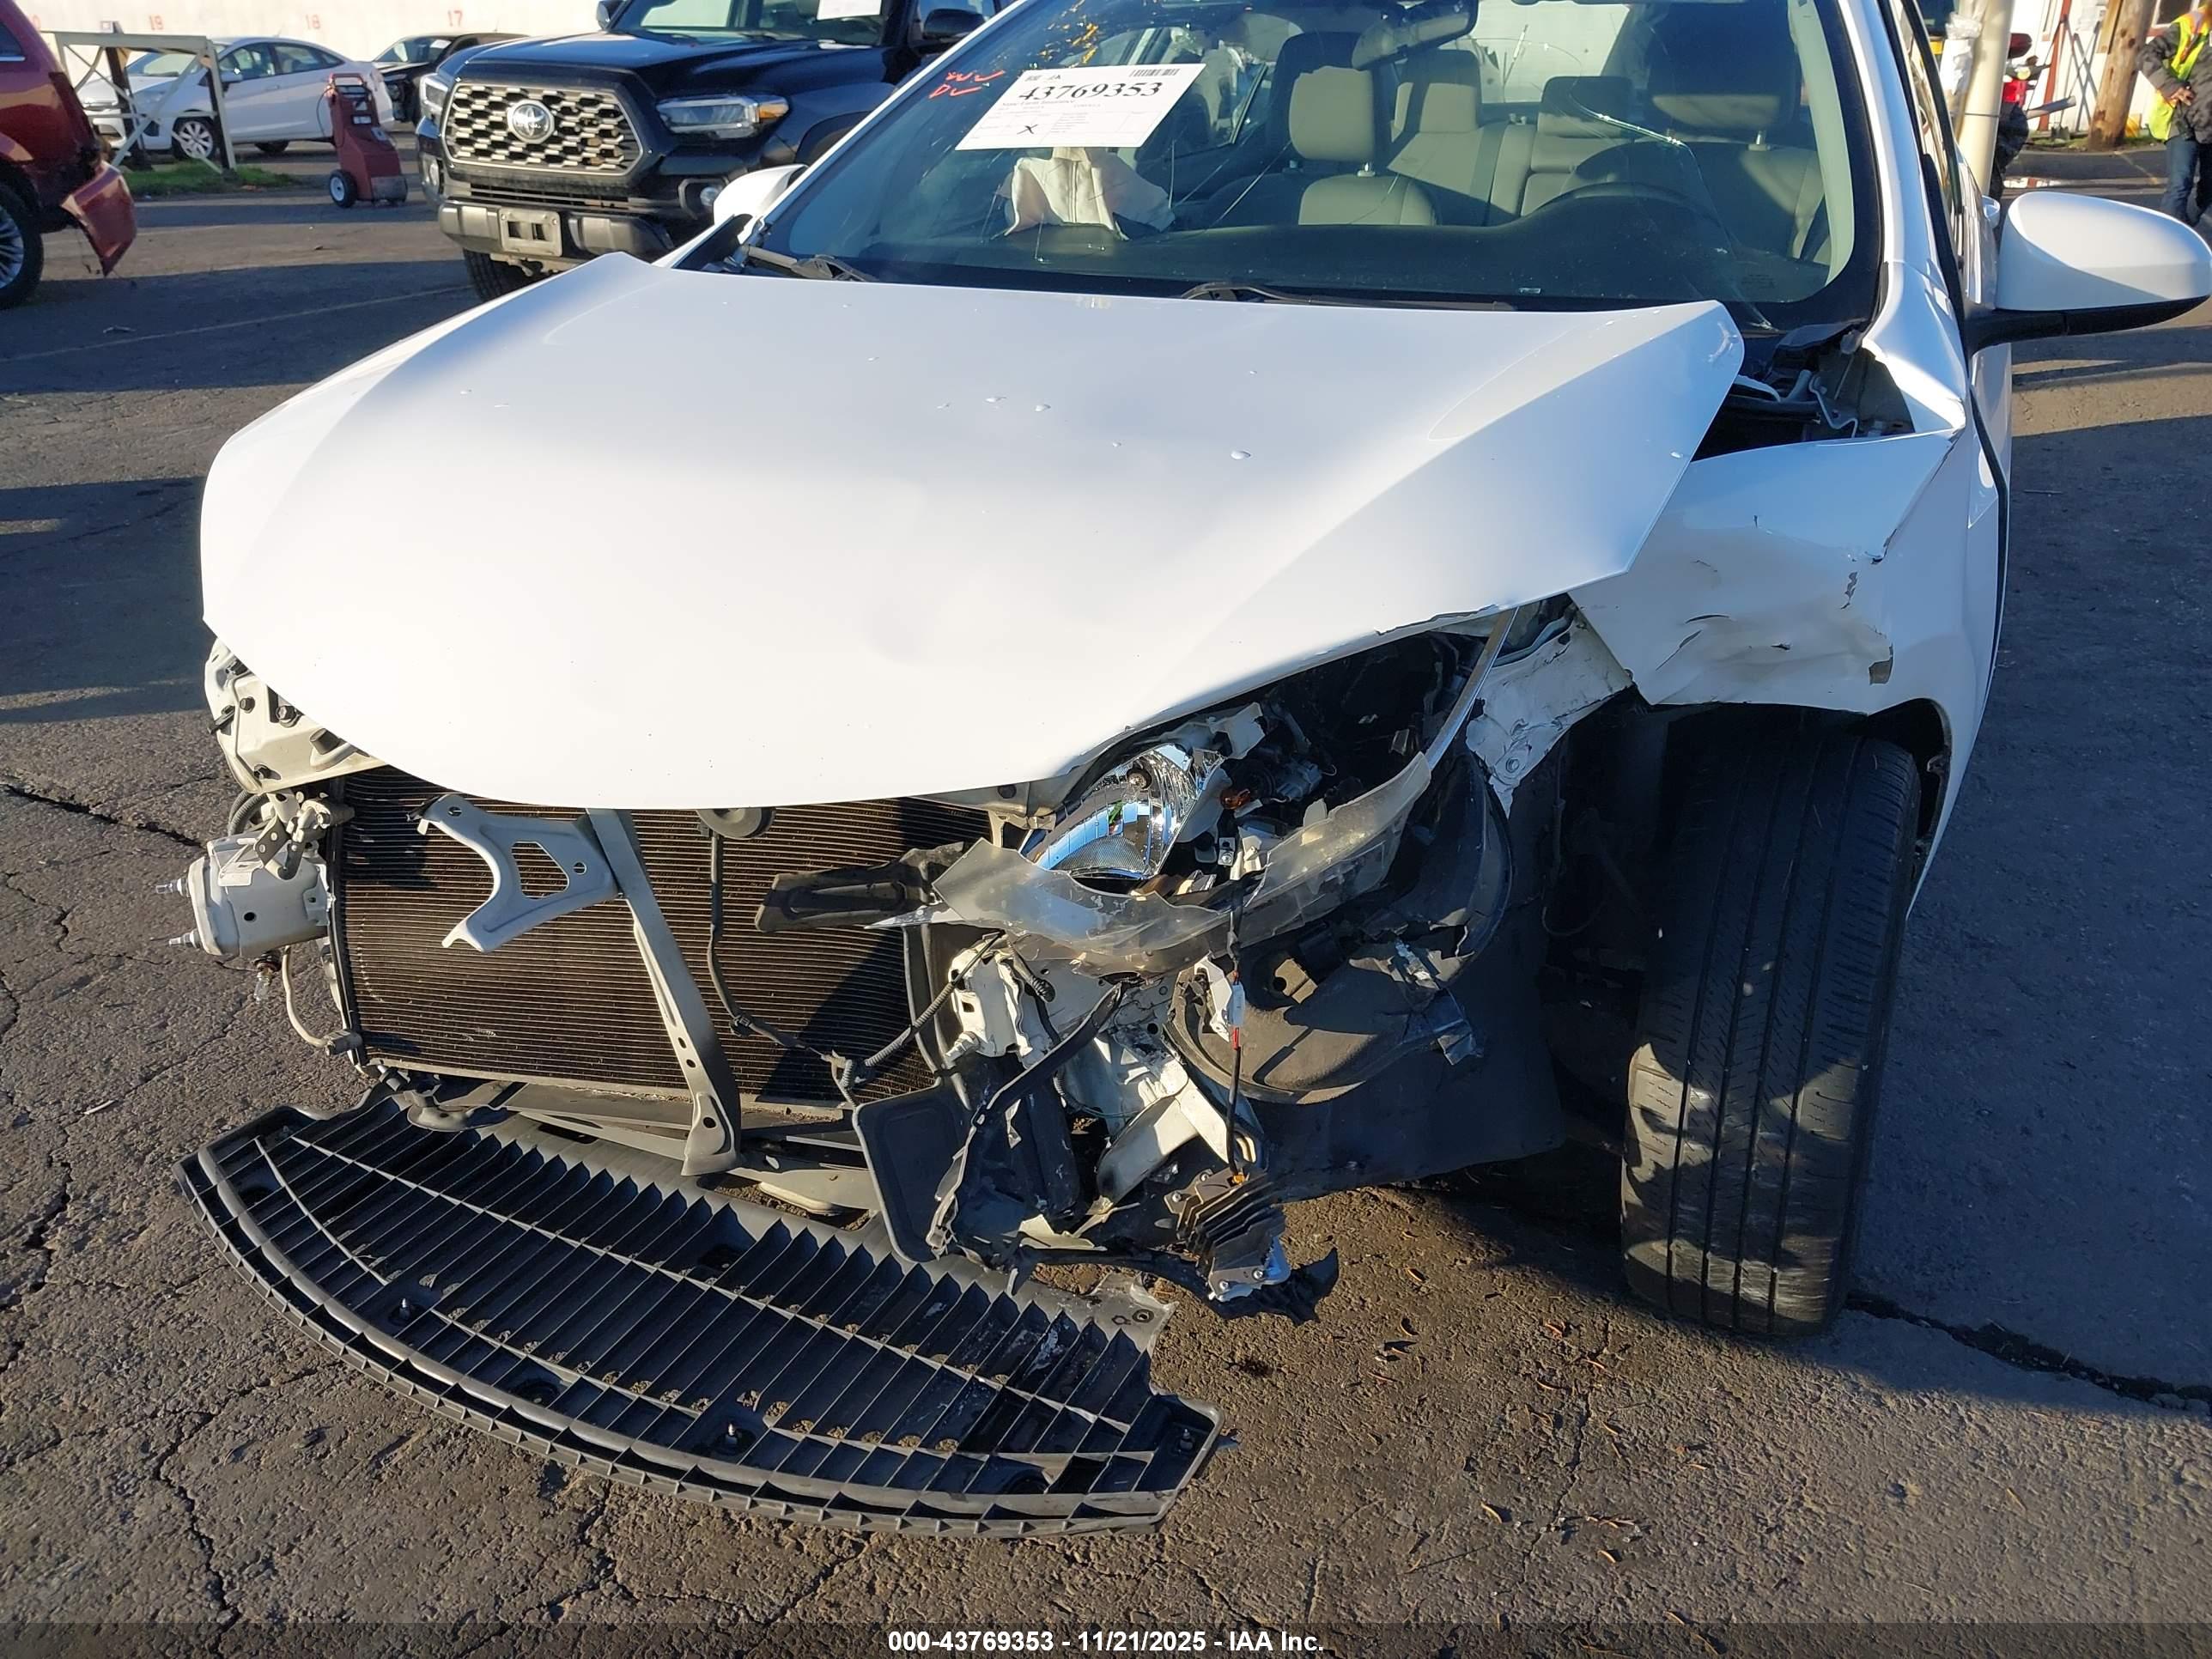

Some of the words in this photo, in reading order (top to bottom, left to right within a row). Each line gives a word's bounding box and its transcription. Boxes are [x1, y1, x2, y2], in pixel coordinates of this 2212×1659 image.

[149, 15, 164, 30] 19
[305, 14, 321, 30] 18
[447, 9, 464, 27] 17
[1018, 82, 1164, 100] 43769353
